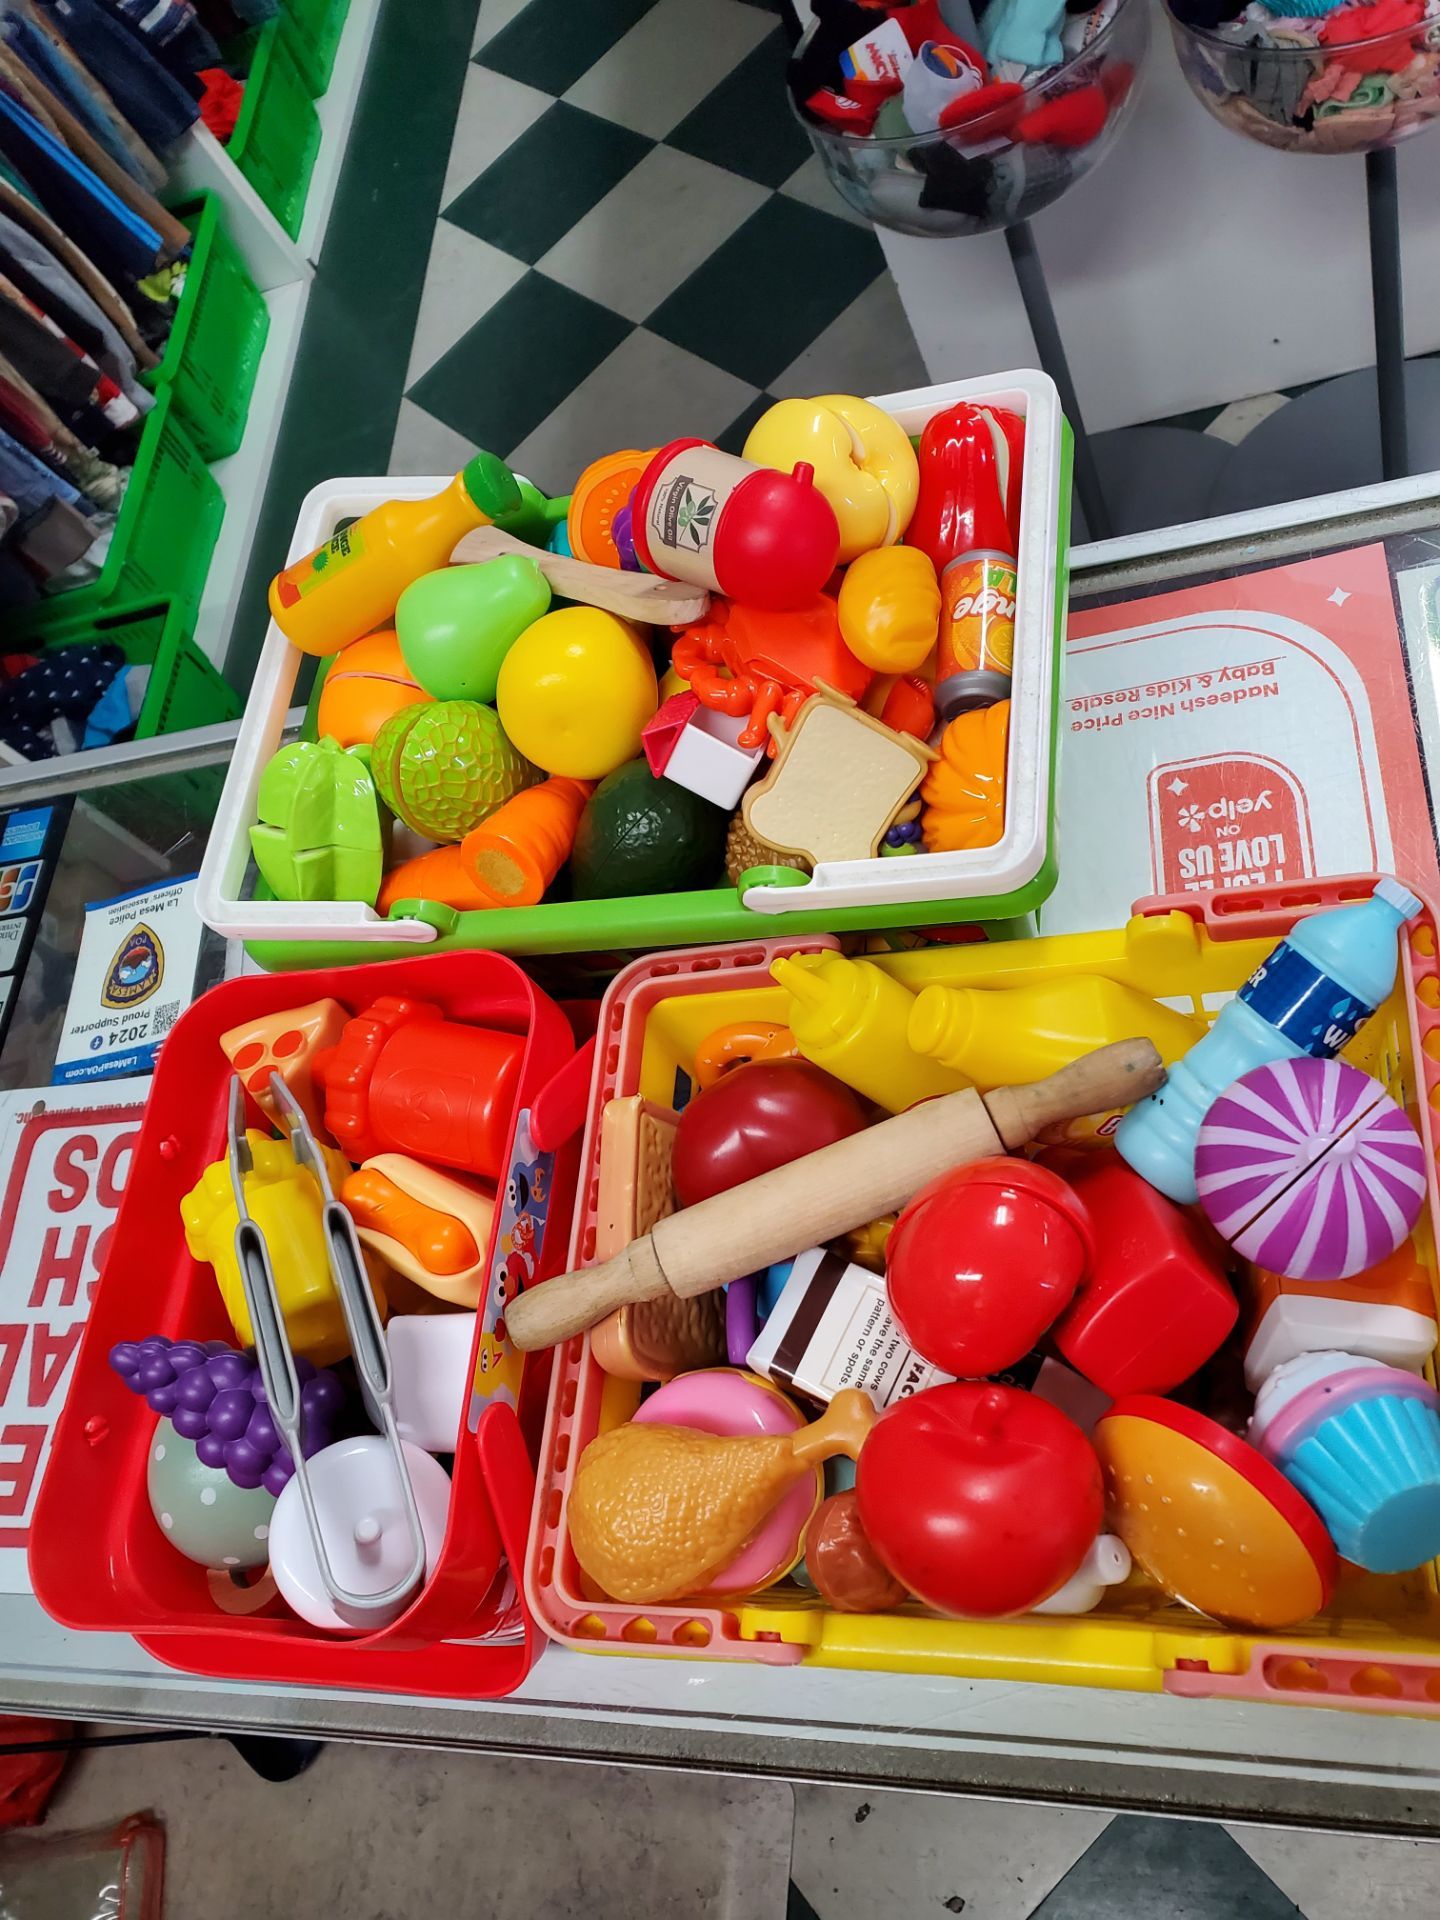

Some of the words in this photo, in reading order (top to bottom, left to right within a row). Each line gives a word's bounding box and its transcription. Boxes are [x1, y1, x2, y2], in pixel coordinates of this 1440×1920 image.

[671, 481, 686, 504] Virgin
[667, 505, 675, 527] Olive
[953, 588, 1016, 620] nge
[1197, 674, 1213, 688] &
[1218, 661, 1275, 683] Baby
[1145, 678, 1191, 698] Kids
[1180, 682, 1279, 713] Nadeesh
[1071, 689, 1140, 712] Resale
[1128, 702, 1175, 720] Nice
[1071, 712, 1123, 732] Price
[1208, 790, 1273, 820] yelp
[1216, 824, 1240, 838] ON
[1179, 845, 1214, 879] US
[1218, 833, 1286, 873] LOVE
[108, 897, 149, 915] Association
[139, 902, 165, 916] Mesa
[167, 898, 179, 907] La
[109, 912, 137, 925] Police
[70, 1017, 120, 1035] Supporter
[122, 1009, 150, 1023] Proud
[109, 1023, 148, 1046] 2024
[65, 1055, 138, 1078] LaMesaPOA.com
[863, 1297, 885, 1337] pattern
[879, 1314, 893, 1337] ave
[856, 1338, 866, 1352] or
[869, 1338, 884, 1357] the
[885, 1339, 900, 1359] two
[838, 1352, 859, 1386] spots.
[854, 1357, 873, 1389] same
[870, 1361, 889, 1391] cows
[897, 1362, 925, 1400] FAC
